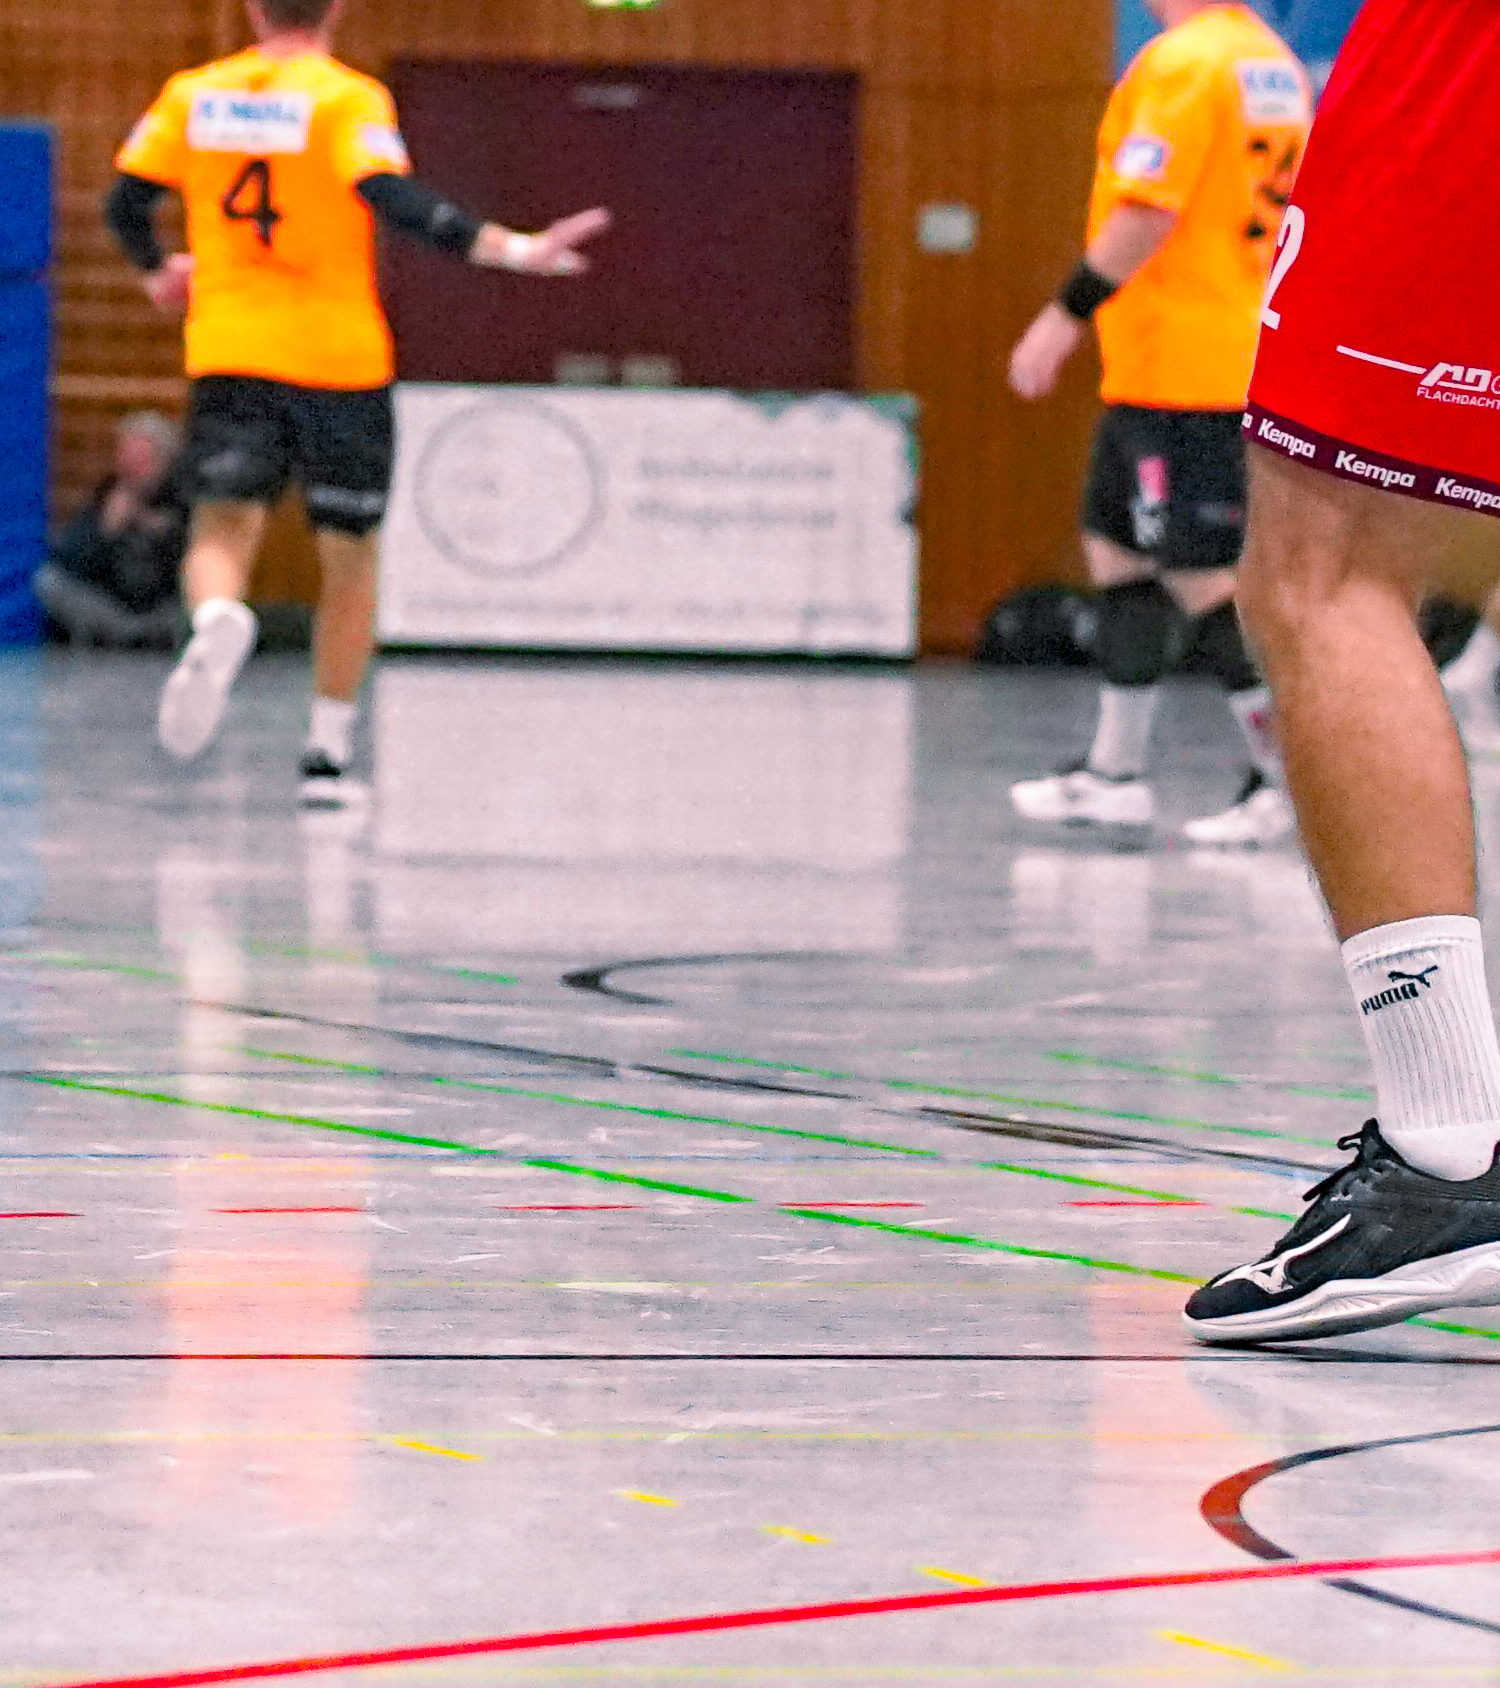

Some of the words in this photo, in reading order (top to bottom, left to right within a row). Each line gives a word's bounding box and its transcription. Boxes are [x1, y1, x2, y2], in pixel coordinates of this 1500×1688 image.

[221, 159, 284, 249] 4
[1256, 417, 1317, 460] Kempa
[1334, 449, 1417, 490] Kempa
